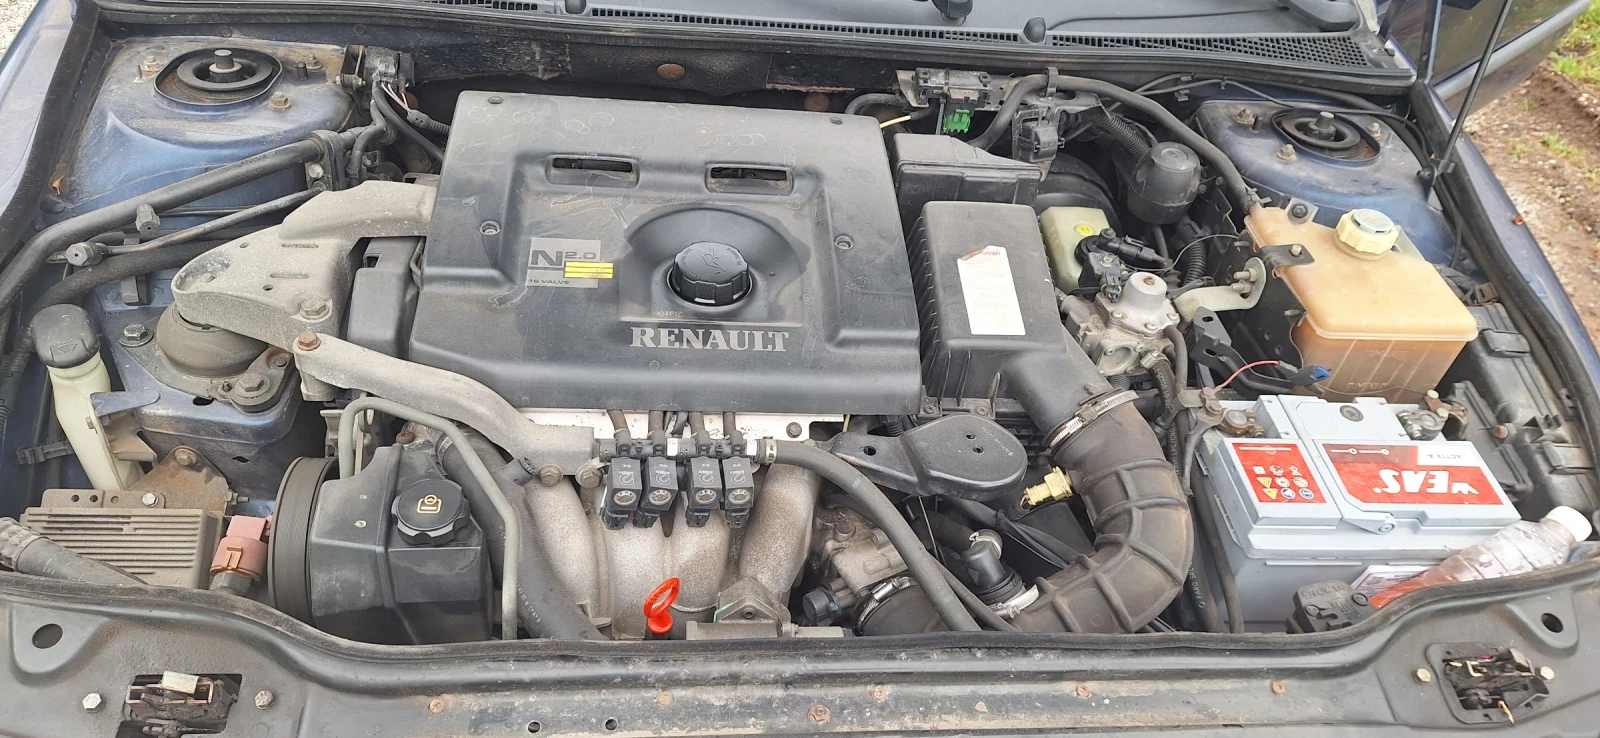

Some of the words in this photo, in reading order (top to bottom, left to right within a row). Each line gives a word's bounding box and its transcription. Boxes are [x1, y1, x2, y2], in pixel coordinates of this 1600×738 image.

[530, 249, 563, 266] N
[564, 251, 597, 260] 2.0
[629, 326, 789, 352] RENAULT
